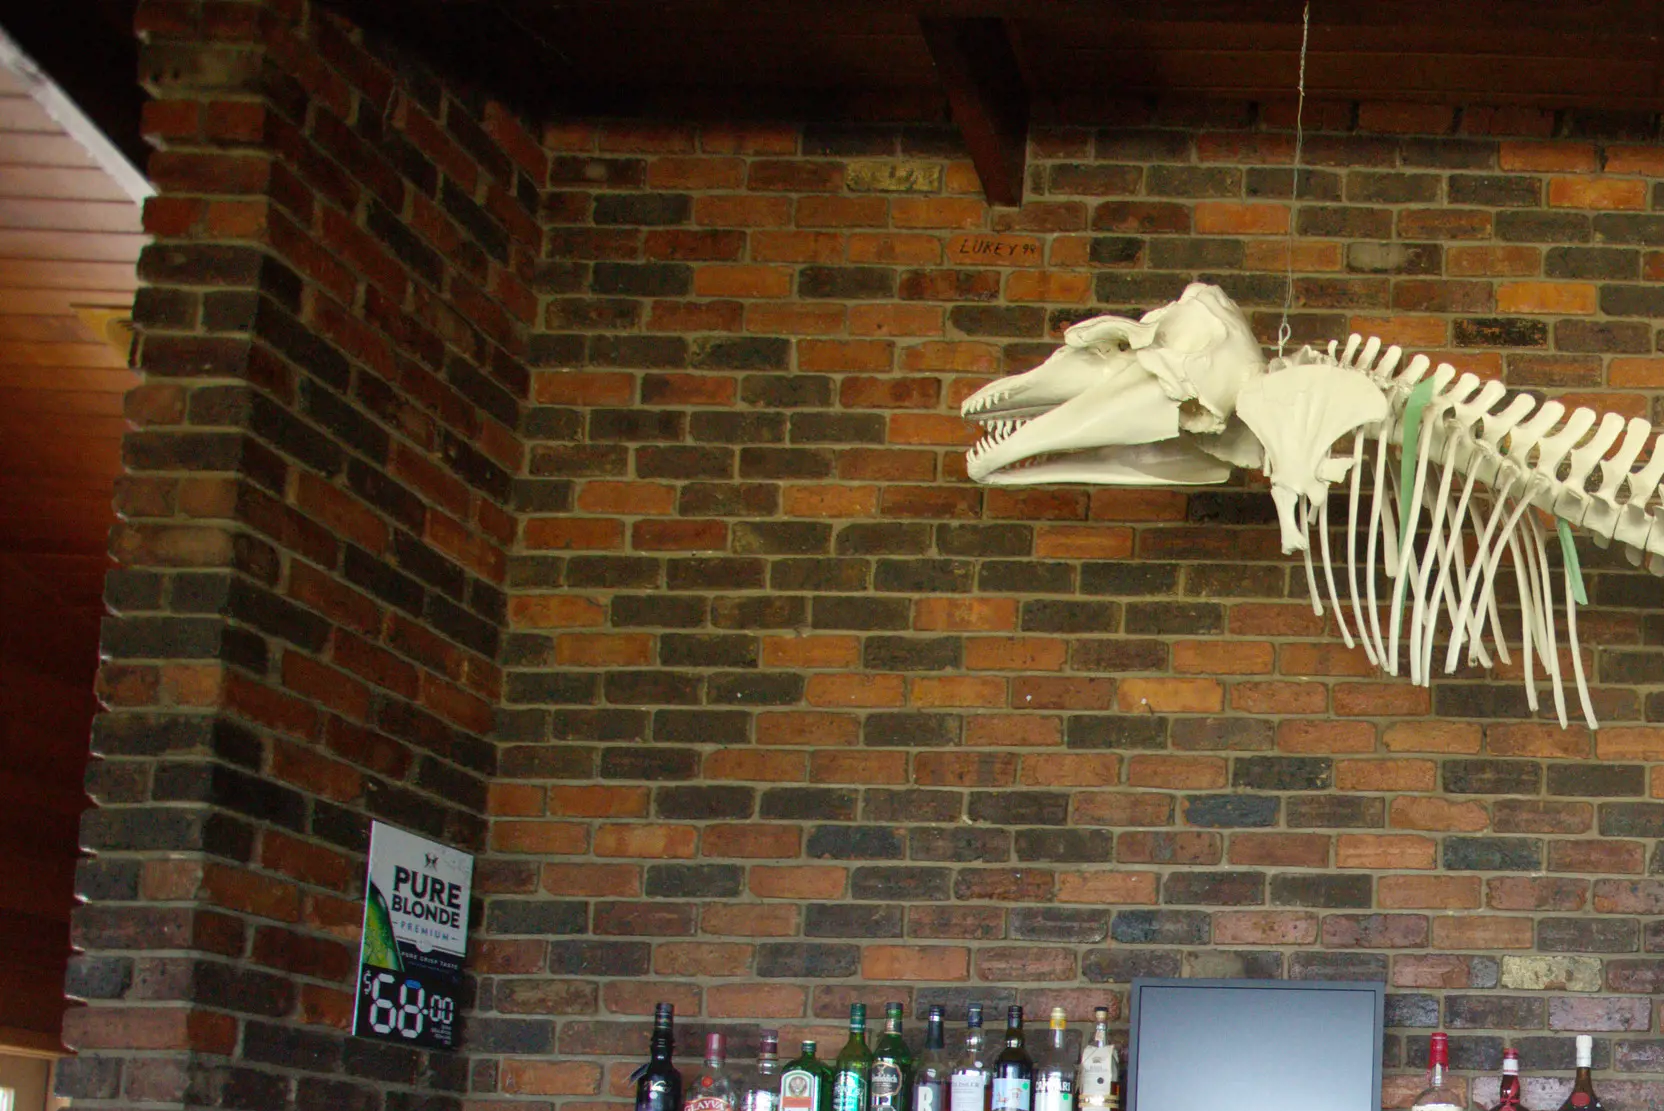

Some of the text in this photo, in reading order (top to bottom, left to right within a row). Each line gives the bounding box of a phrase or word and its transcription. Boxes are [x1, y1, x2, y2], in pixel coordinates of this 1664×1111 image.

[959, 239, 1018, 256] LUKEY
[392, 865, 462, 910] PURE
[390, 894, 461, 929] BLONDE
[400, 919, 450, 941] PREMIUM
